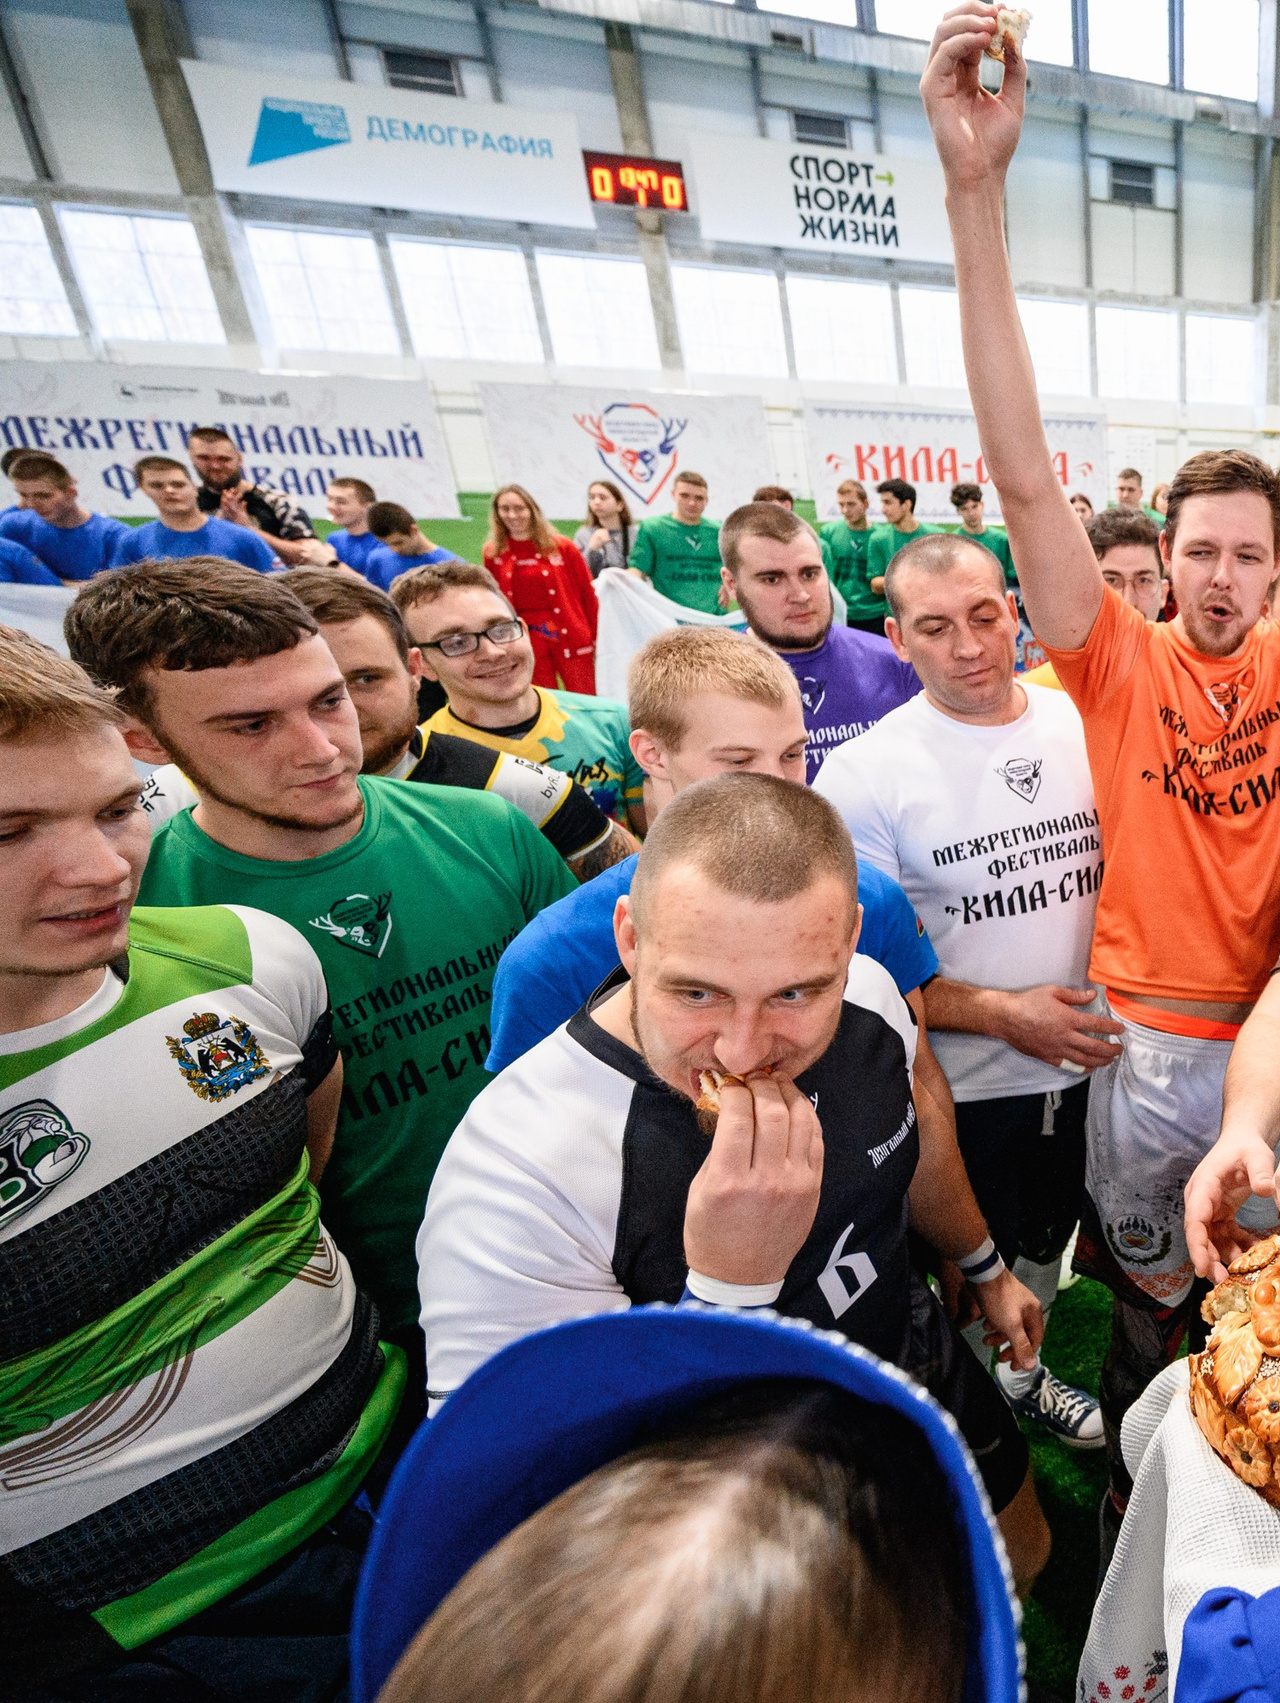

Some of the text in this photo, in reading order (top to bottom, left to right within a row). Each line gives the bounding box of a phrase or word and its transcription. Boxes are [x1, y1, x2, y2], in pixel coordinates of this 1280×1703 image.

[366, 115, 554, 158] ДЕМОГРАФИЯ
[790, 155, 874, 188] СПОРТ
[794, 184, 896, 219] НОРМА
[799, 213, 899, 247] ЖИЗНИ
[987, 834, 1100, 879] ФЕСТИВАЛЬ
[816, 1222, 878, 1320] 6
